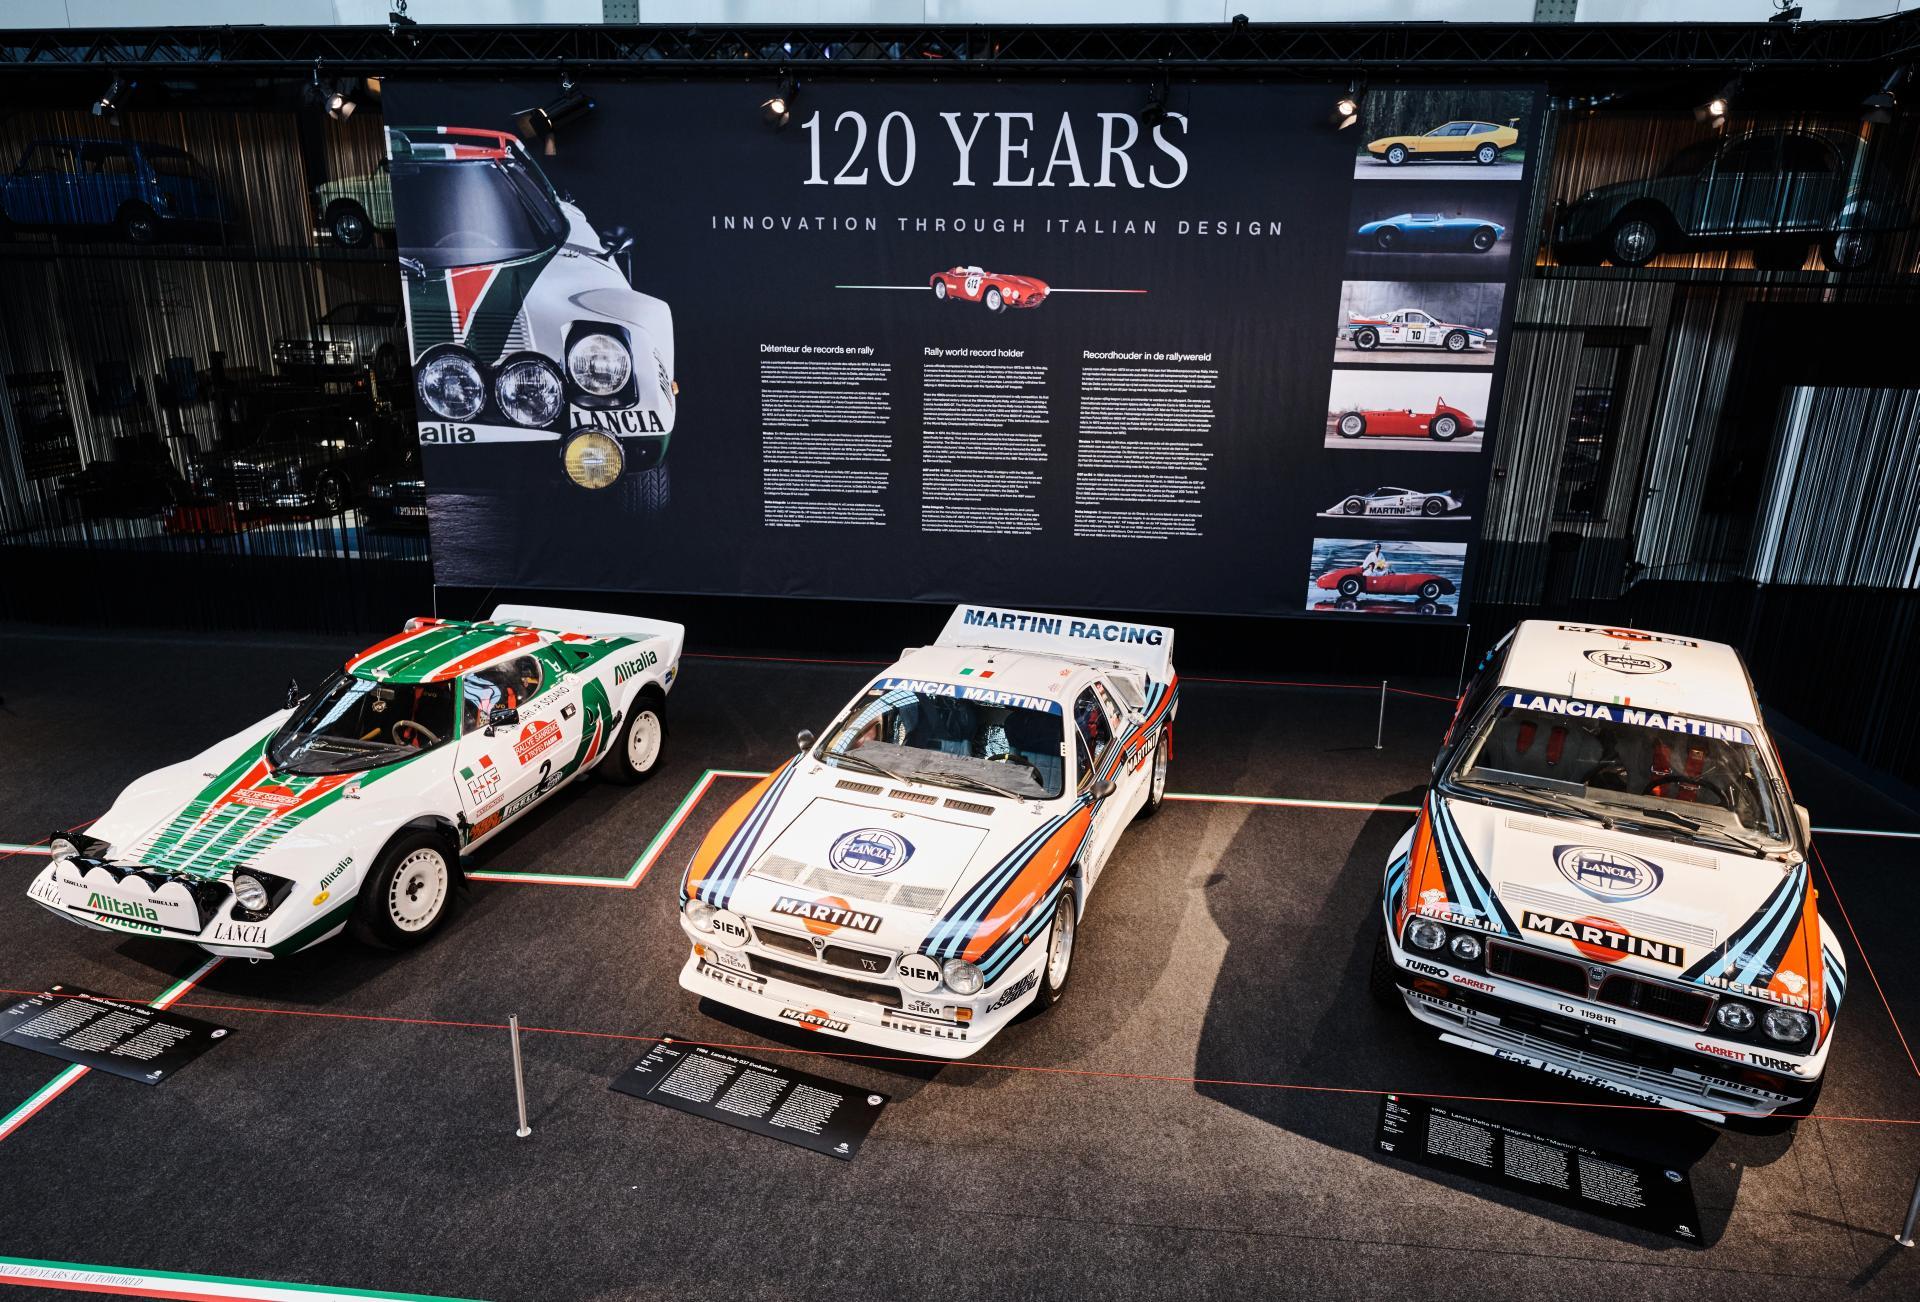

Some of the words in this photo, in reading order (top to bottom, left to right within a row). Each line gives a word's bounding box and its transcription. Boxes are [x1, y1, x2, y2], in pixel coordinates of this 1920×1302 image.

[801, 110, 916, 187] 120
[939, 111, 1189, 189] YEARS
[712, 216, 877, 231] INNOVATION
[898, 217, 1025, 232] THROUGH
[1046, 219, 1156, 235] ITALIAN
[1178, 220, 1282, 236] DESIGN
[966, 279, 978, 290] 612
[1411, 330, 1421, 340] 10
[760, 343, 800, 353] Détenteur
[801, 344, 812, 354] de
[813, 345, 844, 354] records
[845, 346, 856, 354] en
[857, 345, 875, 356] rally
[924, 347, 944, 358] Rally
[945, 347, 968, 357] world
[969, 347, 997, 357] record
[998, 348, 1024, 358] holder
[1083, 350, 1142, 361] Recordhouder
[1144, 351, 1152, 360] in
[1153, 351, 1165, 361] de
[1166, 351, 1212, 363] rallywereld
[573, 409, 666, 434] LANCIA
[1369, 507, 1406, 515] MARTINI
[963, 609, 1063, 636] MARTINI
[1069, 620, 1163, 647] RACING
[614, 650, 658, 686] Alitalia
[883, 678, 957, 697] LANCIA
[962, 686, 1052, 713] MARTINI
[1512, 694, 1614, 721] LANCIA
[1622, 709, 1743, 744] MARTINI
[1127, 733, 1157, 776] MARTINI
[467, 766, 501, 806] HF
[538, 758, 552, 792] 2
[849, 842, 888, 860] LANCIA
[319, 855, 353, 891] Alitalia
[1582, 860, 1636, 880] LANCIA
[29, 878, 62, 906] LANCIA
[86, 891, 159, 922] Alitalia
[775, 897, 882, 934] MARTINI
[1419, 905, 1503, 933] MICHELIN
[214, 922, 267, 944] LANCIA
[712, 919, 745, 938] SIEM
[1527, 912, 1678, 964] MARTINI
[900, 965, 939, 982] SIEM
[1404, 957, 1450, 979] TURBO
[1452, 974, 1496, 993] GARRETT
[1703, 974, 1804, 1008] MICHELIN
[781, 1008, 849, 1033] MARTINI
[907, 1003, 940, 1015] SIEM
[1557, 1002, 1574, 1013] TO
[1579, 1008, 1617, 1025] 11981R
[881, 1007, 969, 1041] PIRELLI
[1695, 1041, 1746, 1061] GARRETT
[1431, 1106, 1447, 1115] 1990
[1451, 1112, 1471, 1122] Lancia
[1472, 1118, 1490, 1127] Delta
[1502, 1126, 1531, 1138] Integrale
[39, 1270, 69, 1280] YEARS
[81, 1275, 144, 1287] AUTOWORLD
